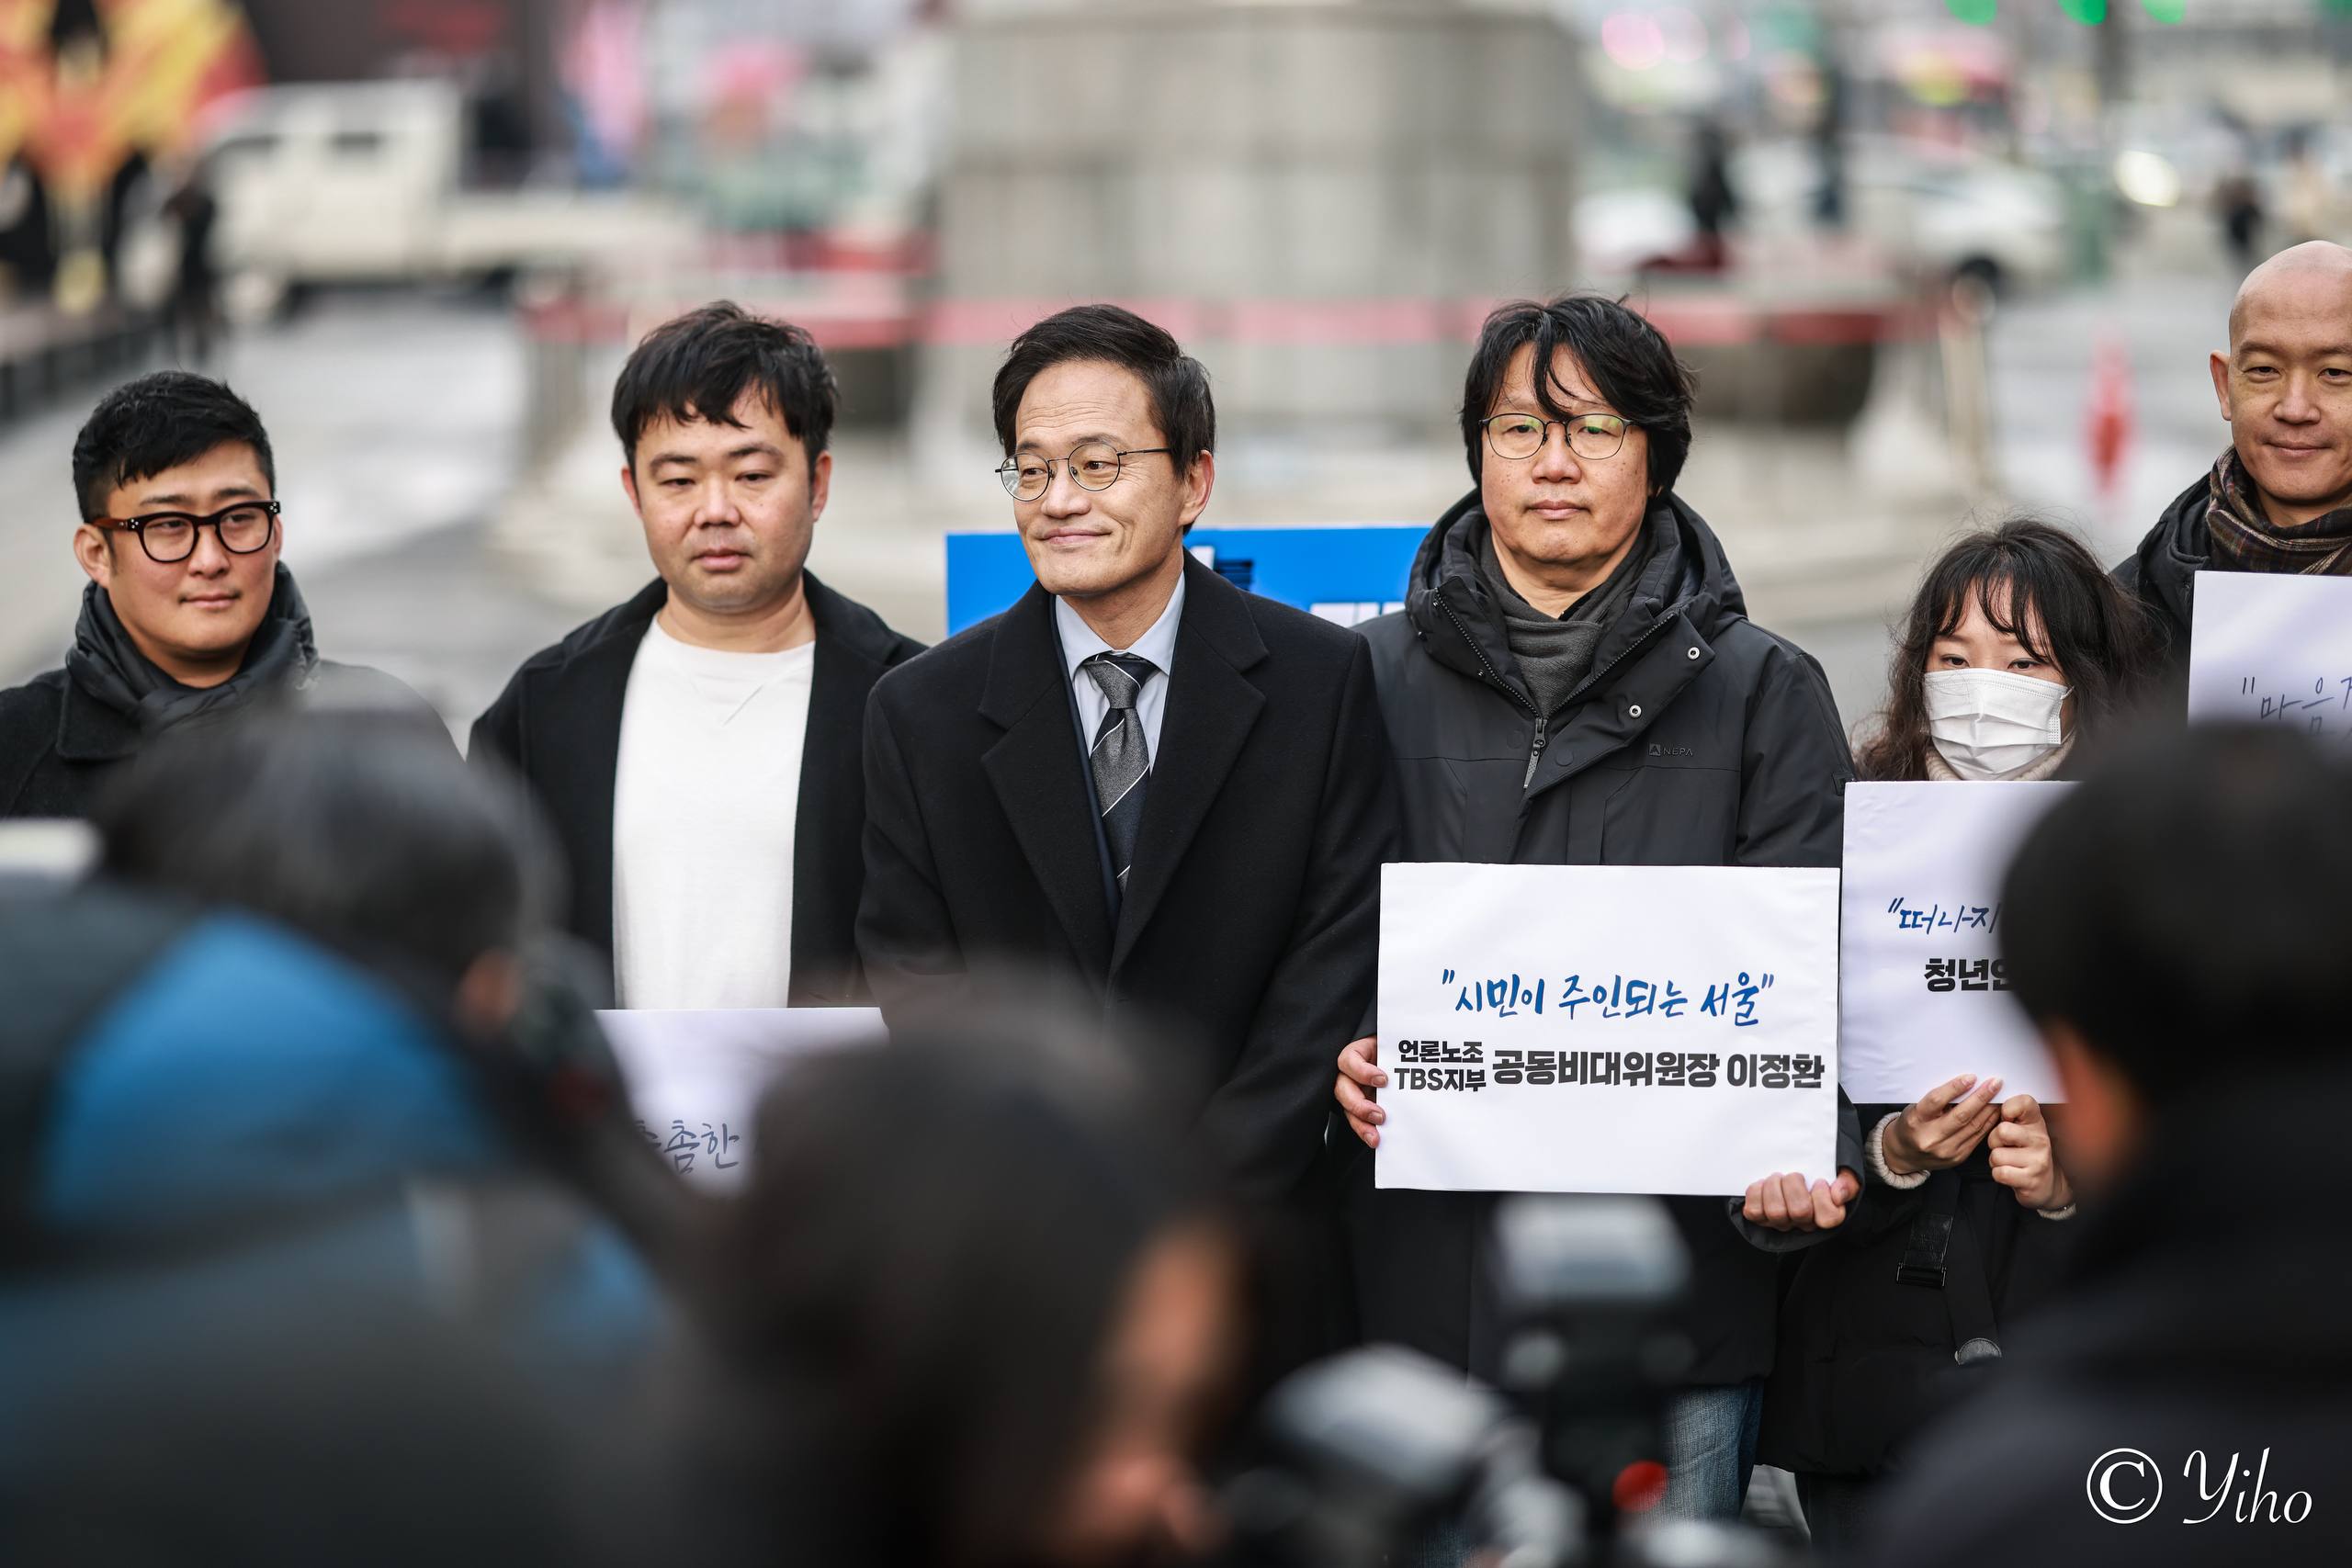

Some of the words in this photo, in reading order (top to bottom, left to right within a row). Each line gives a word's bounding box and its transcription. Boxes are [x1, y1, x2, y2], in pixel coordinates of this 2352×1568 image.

[1663, 747, 1693, 756] NEPA
[1442, 968, 1545, 1019] "시민이
[1558, 974, 1689, 1021] 주인되는
[1700, 971, 1775, 1027] 서울"
[1397, 1039, 1484, 1064] 언론노조
[1394, 1067, 1487, 1092] TBS지부
[1492, 1050, 1721, 1088] 공동비대위원장
[1726, 1054, 1826, 1089] 이정환
